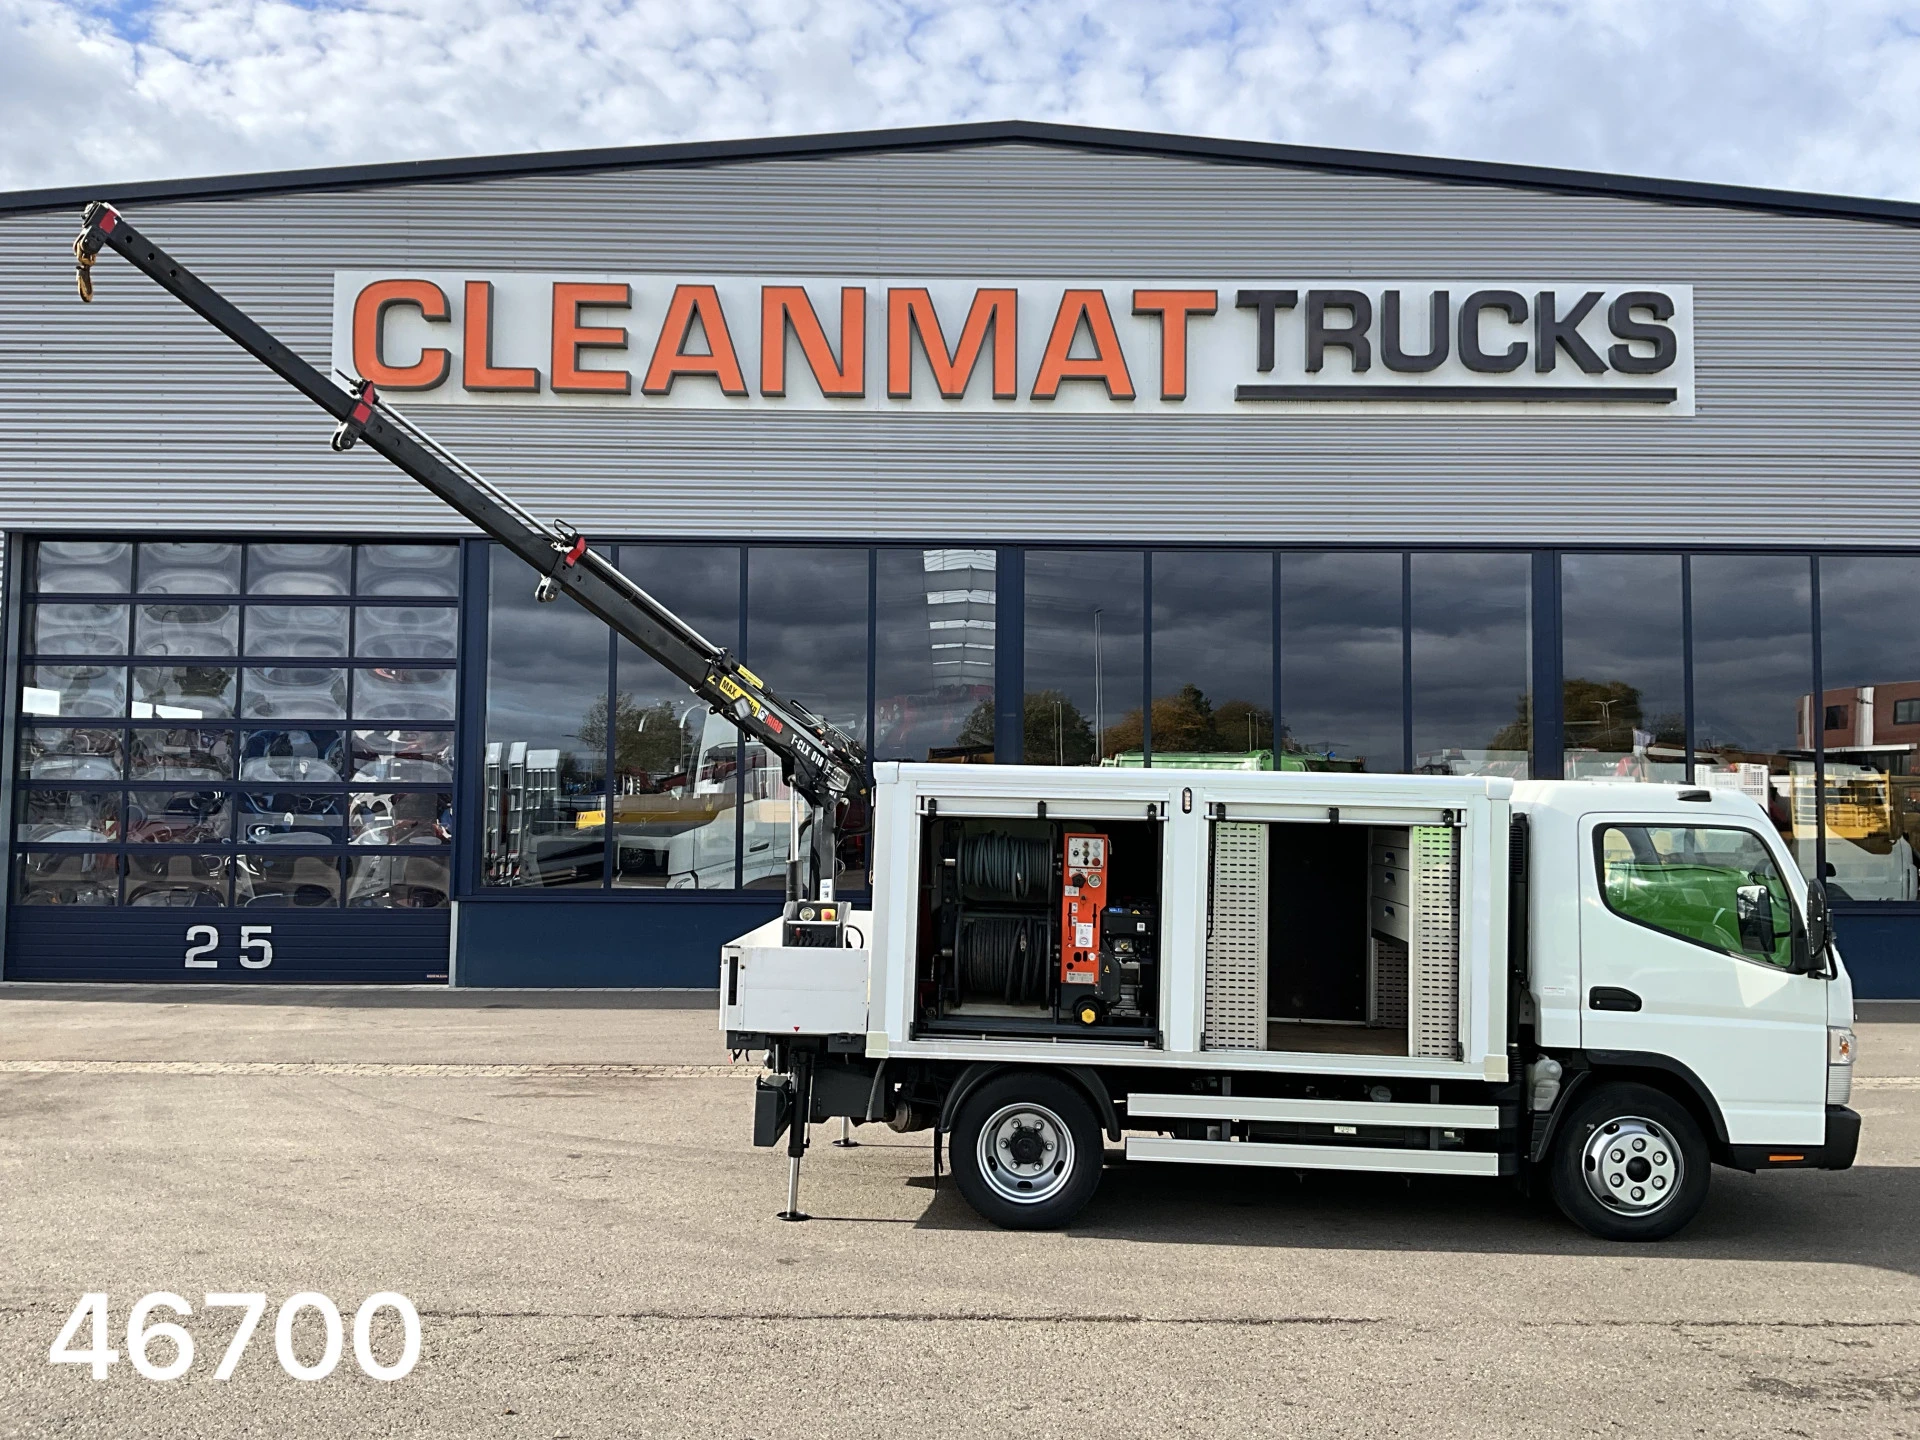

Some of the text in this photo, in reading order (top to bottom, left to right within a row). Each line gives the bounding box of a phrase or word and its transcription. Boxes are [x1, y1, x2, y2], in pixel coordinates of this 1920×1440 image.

[353, 279, 1677, 401] CLEANMAT TRUCKS
[765, 714, 784, 734] HIAB
[790, 733, 812, 757] T-CLX
